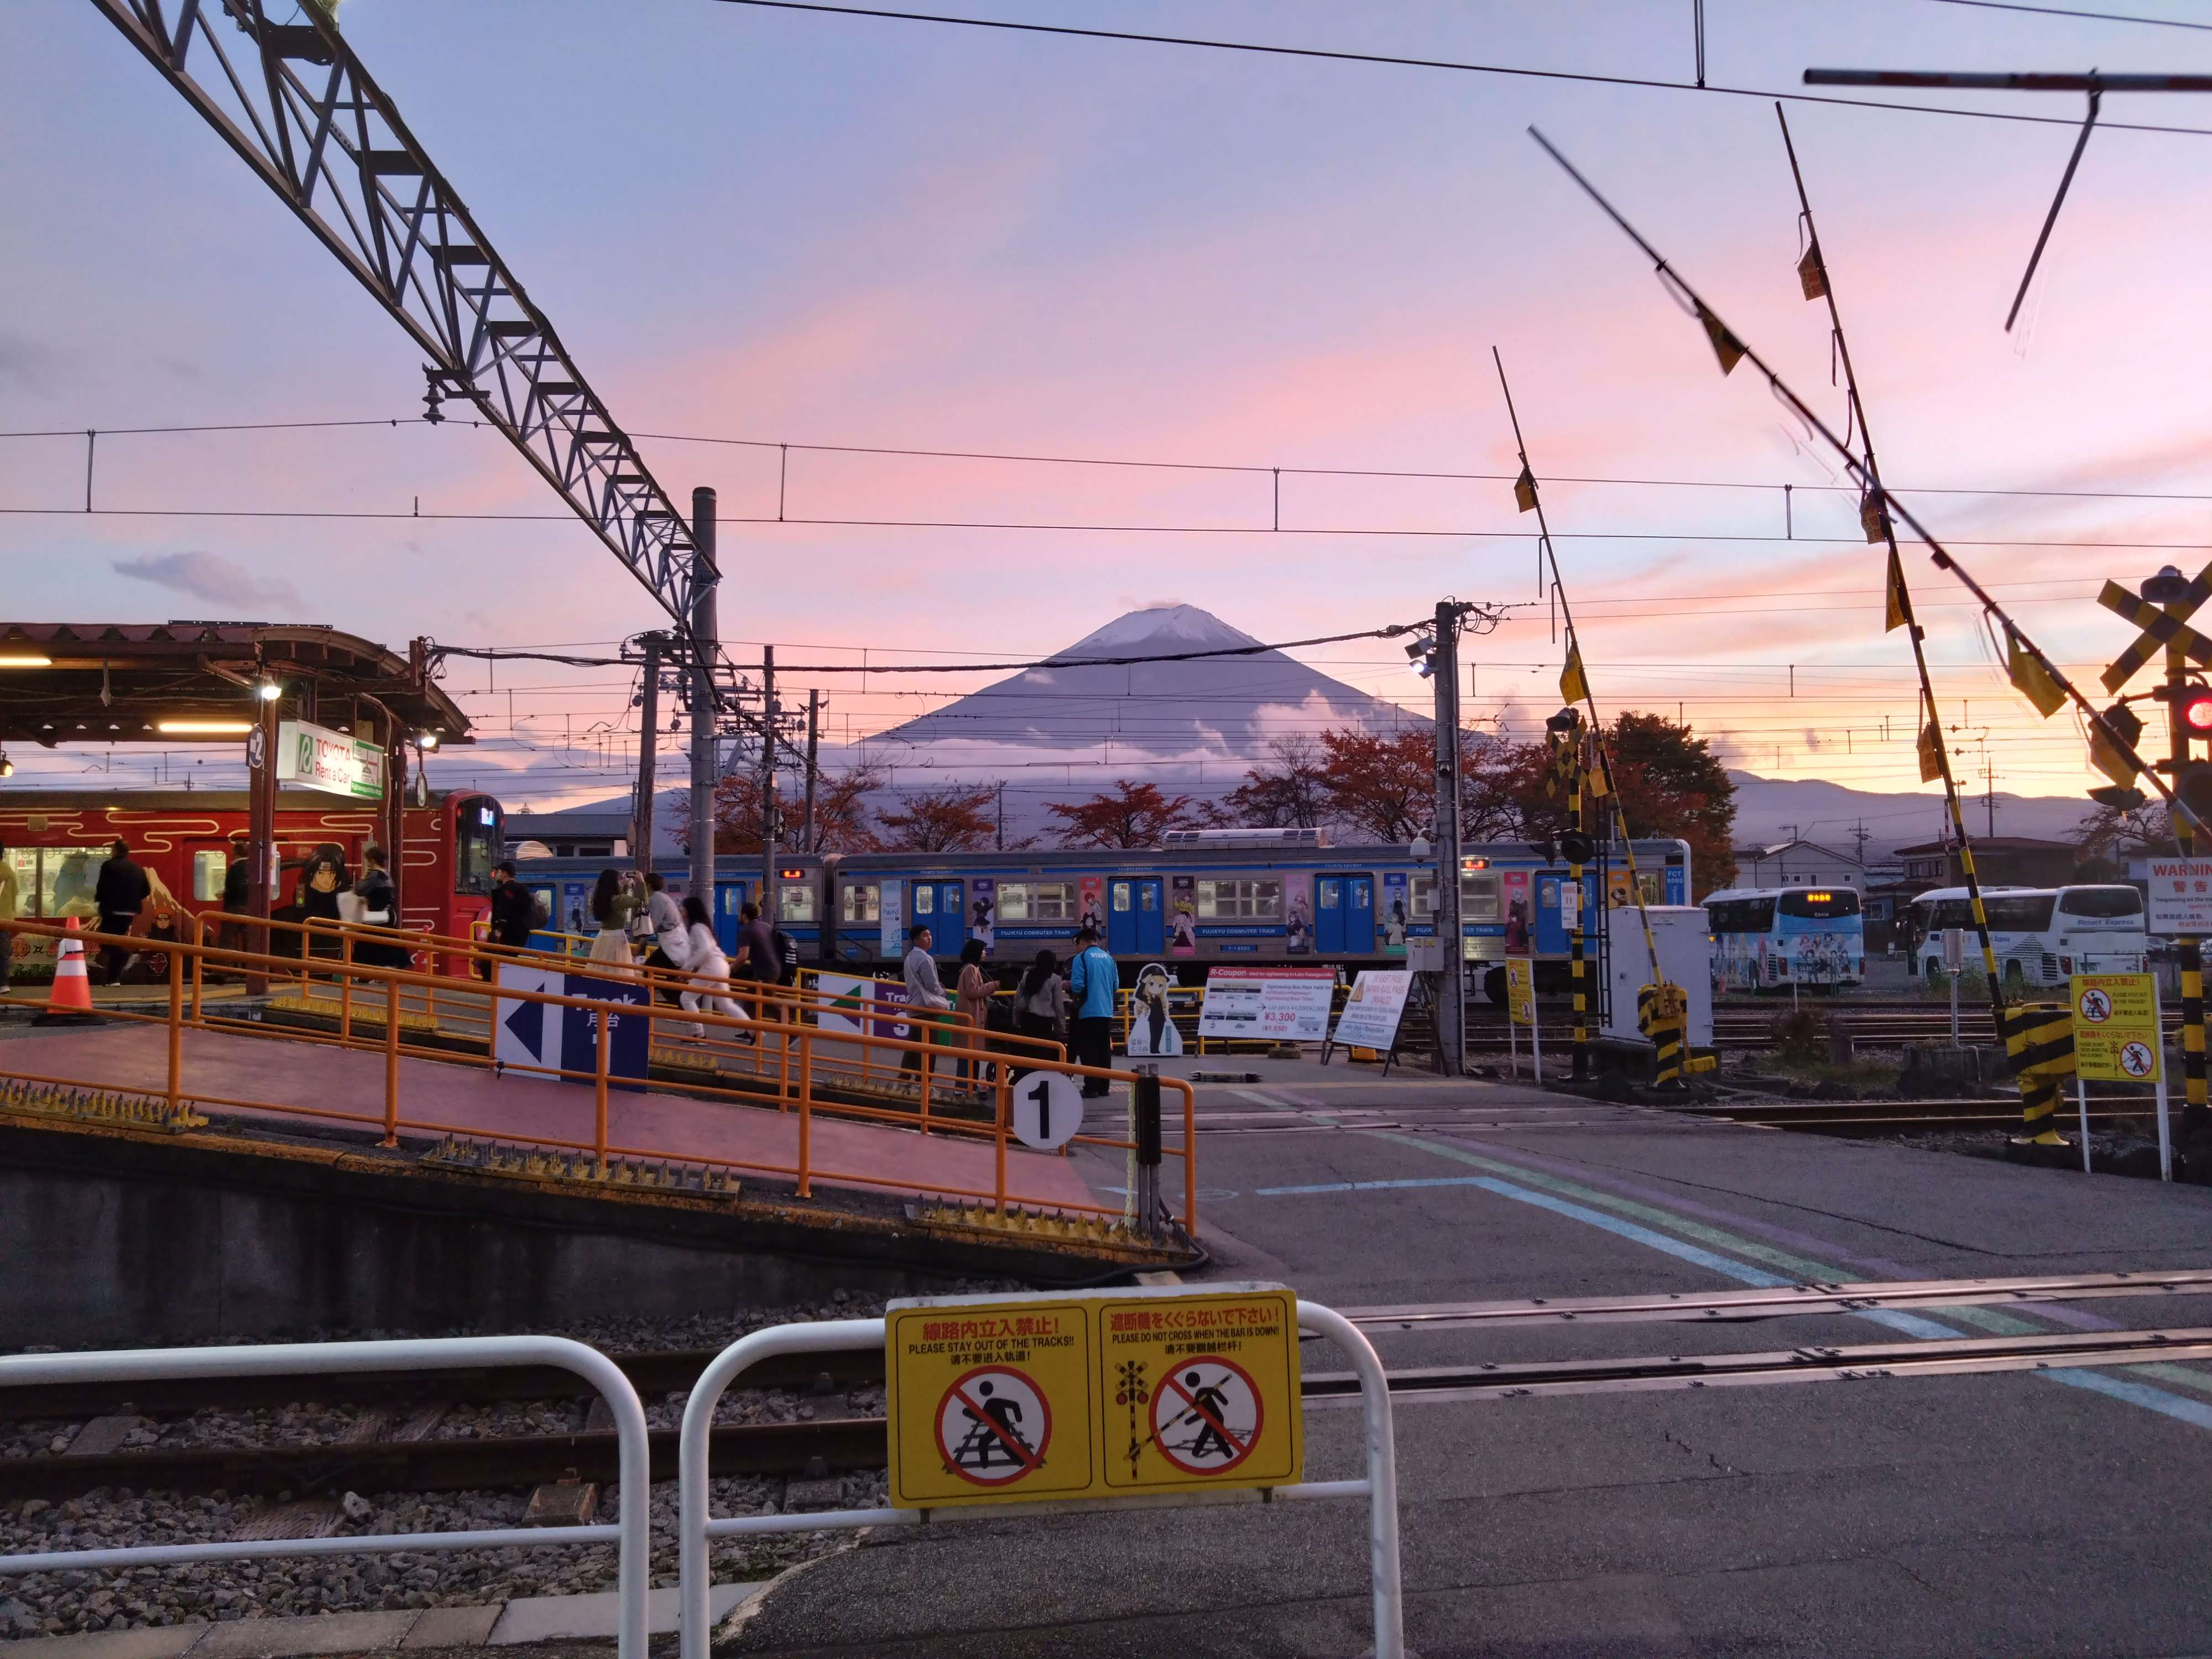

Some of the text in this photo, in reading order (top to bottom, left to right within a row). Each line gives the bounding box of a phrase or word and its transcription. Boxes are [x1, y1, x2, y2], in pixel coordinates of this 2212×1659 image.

[316, 738, 350, 761] TOYOTA
[315, 761, 350, 784] Rent a Car
[1379, 975, 1391, 983] EAST
[1391, 974, 1404, 983] PASS
[886, 992, 907, 1003] Tra
[1392, 985, 1405, 994] PASS
[1264, 1013, 1296, 1022] ¥3,300
[1028, 1081, 1050, 1139] 1
[922, 1316, 1059, 1341] 線路内立入禁止!
[1110, 1307, 1279, 1331] 遮断機をくぐらないで下さい!
[1112, 1326, 1279, 1344] PLEASE DO NOT CROSS WHEN THE BAR IS DOWN!!
[909, 1336, 1074, 1355] PLEASE STAY OUT OF THE TRACKS!!
